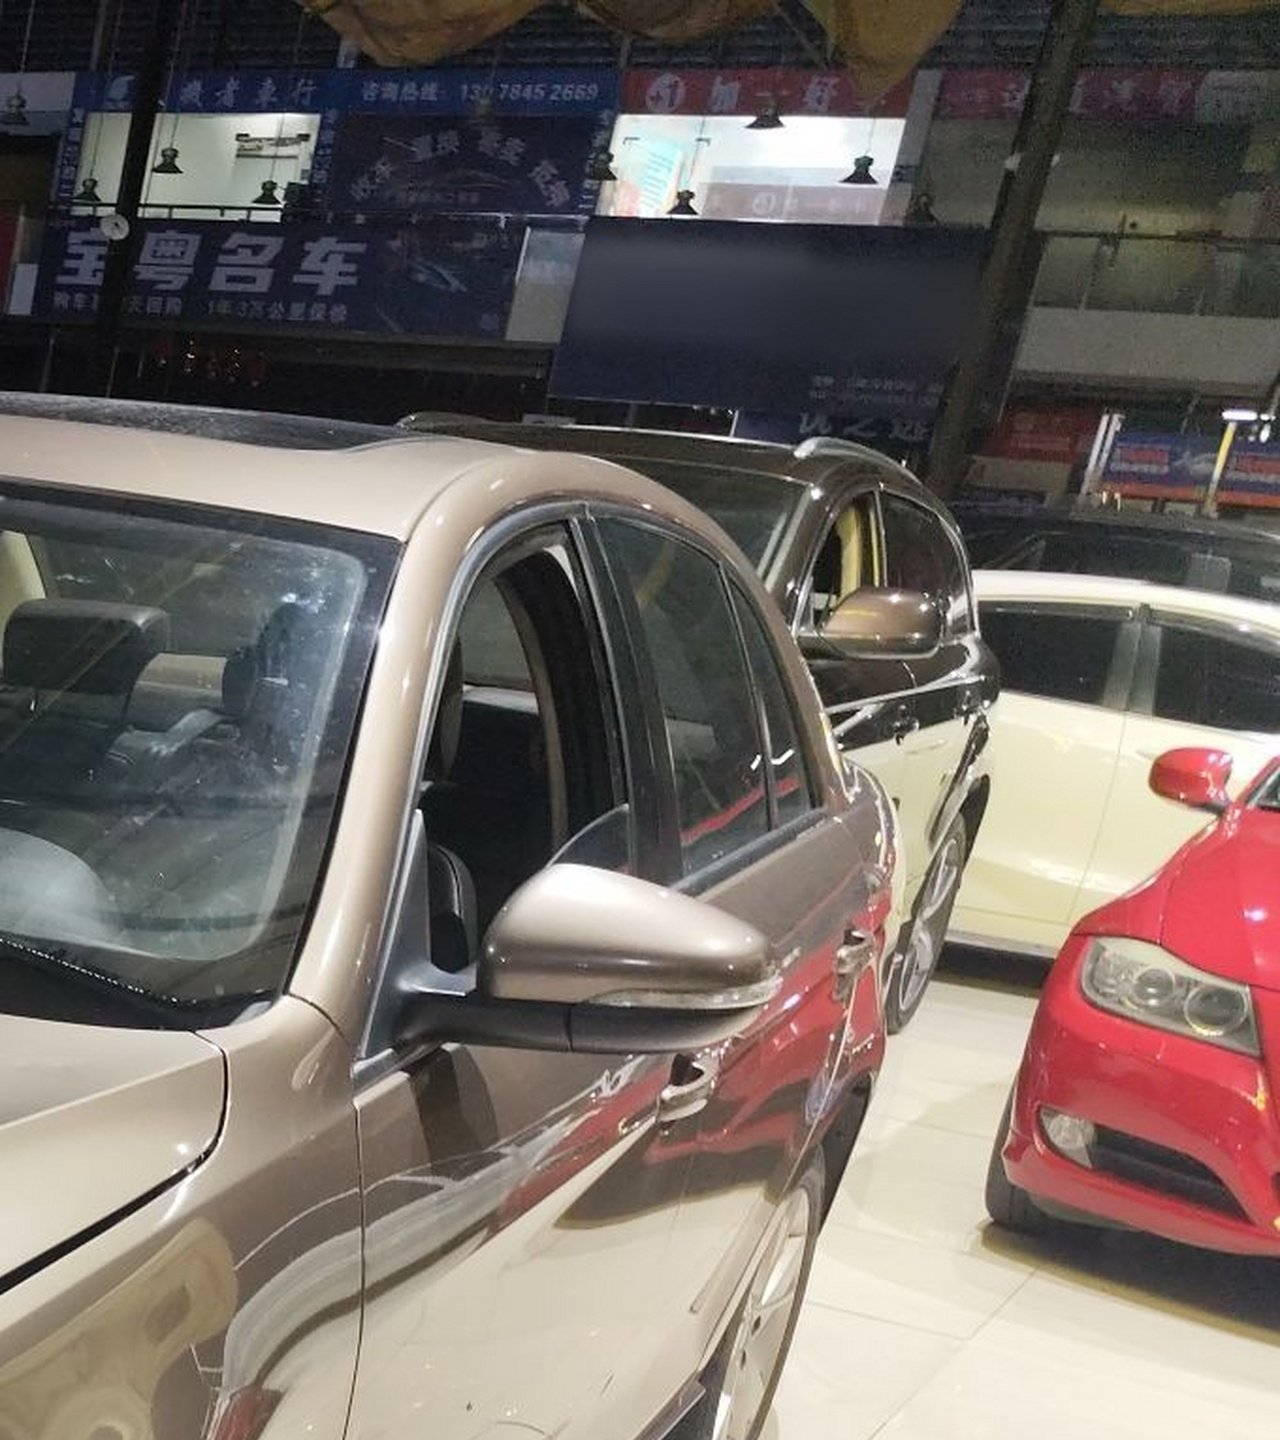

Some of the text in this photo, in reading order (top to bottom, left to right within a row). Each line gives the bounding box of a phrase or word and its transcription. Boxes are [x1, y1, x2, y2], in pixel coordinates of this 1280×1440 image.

[499, 82, 545, 100] 7845
[56, 228, 367, 297] 宝粤名车
